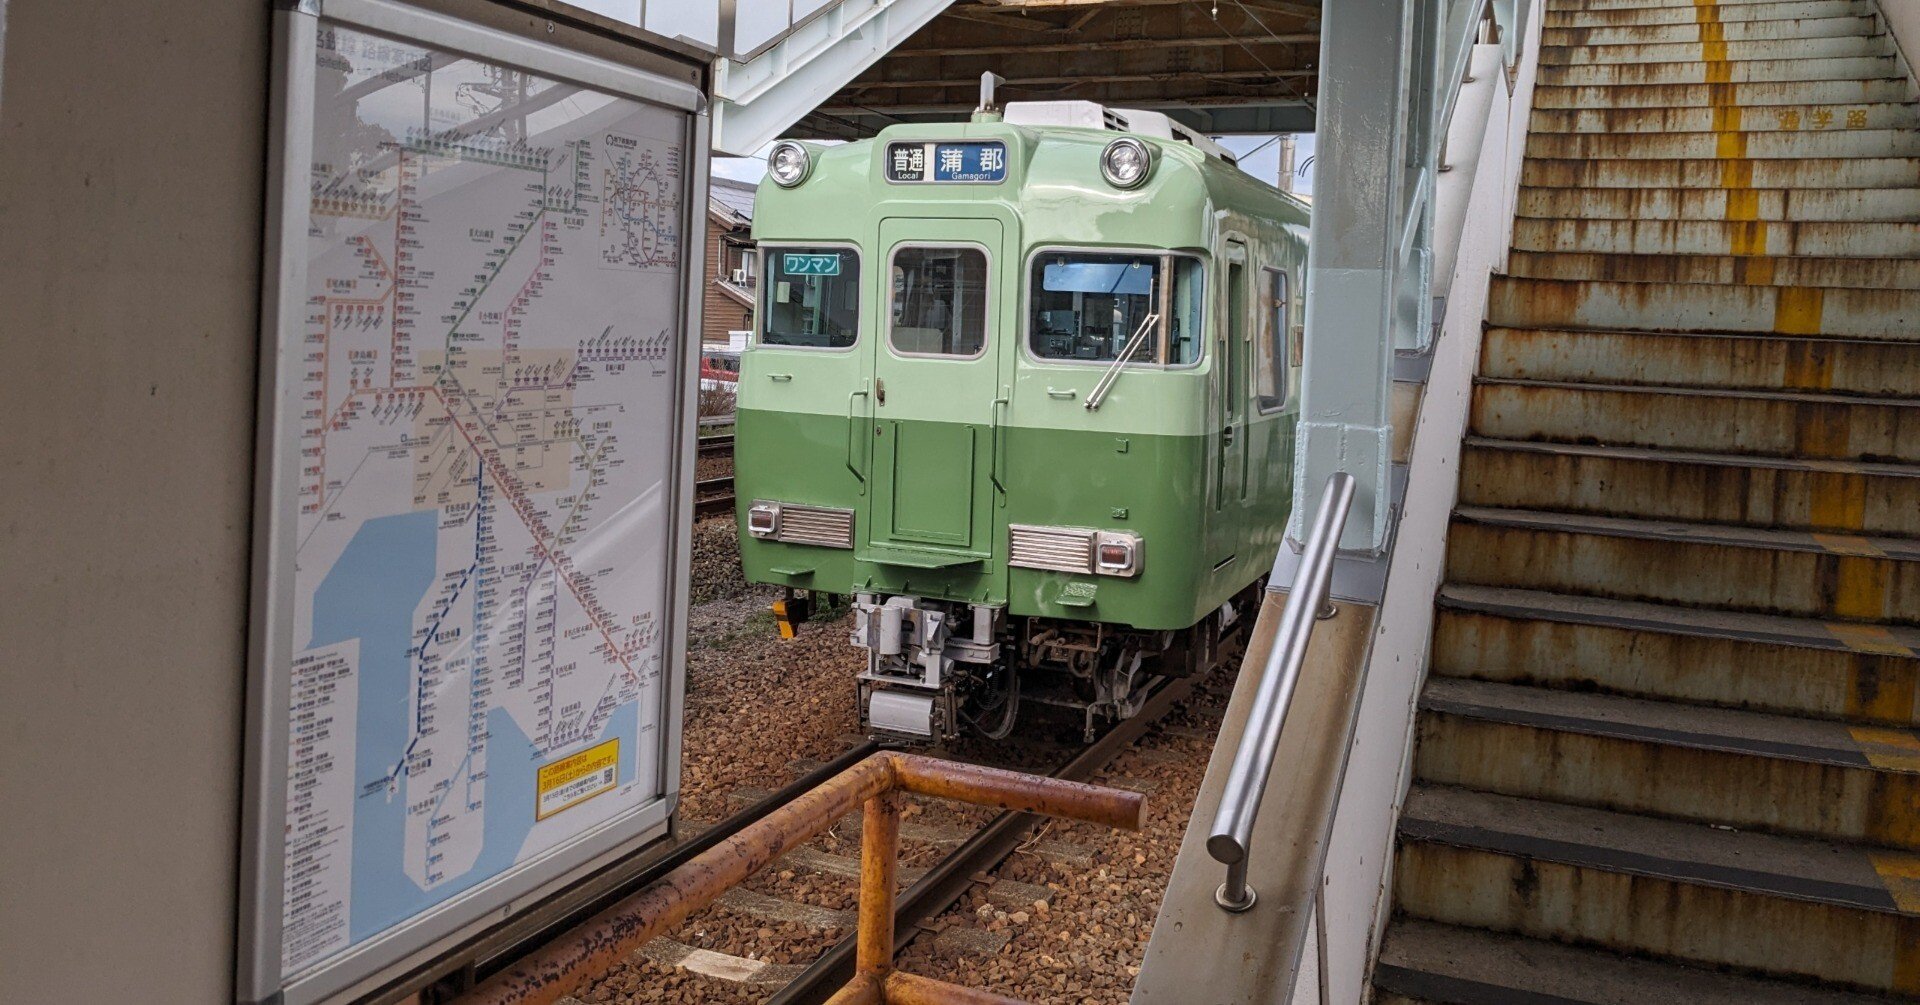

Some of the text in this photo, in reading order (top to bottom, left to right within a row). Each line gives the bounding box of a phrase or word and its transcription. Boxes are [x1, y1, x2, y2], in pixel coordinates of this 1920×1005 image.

[894, 148, 924, 172] 普通
[940, 148, 1003, 172] 蒲郡
[898, 172, 919, 180] Local
[951, 171, 991, 181] Gamagori
[786, 256, 837, 273] ワンマン
